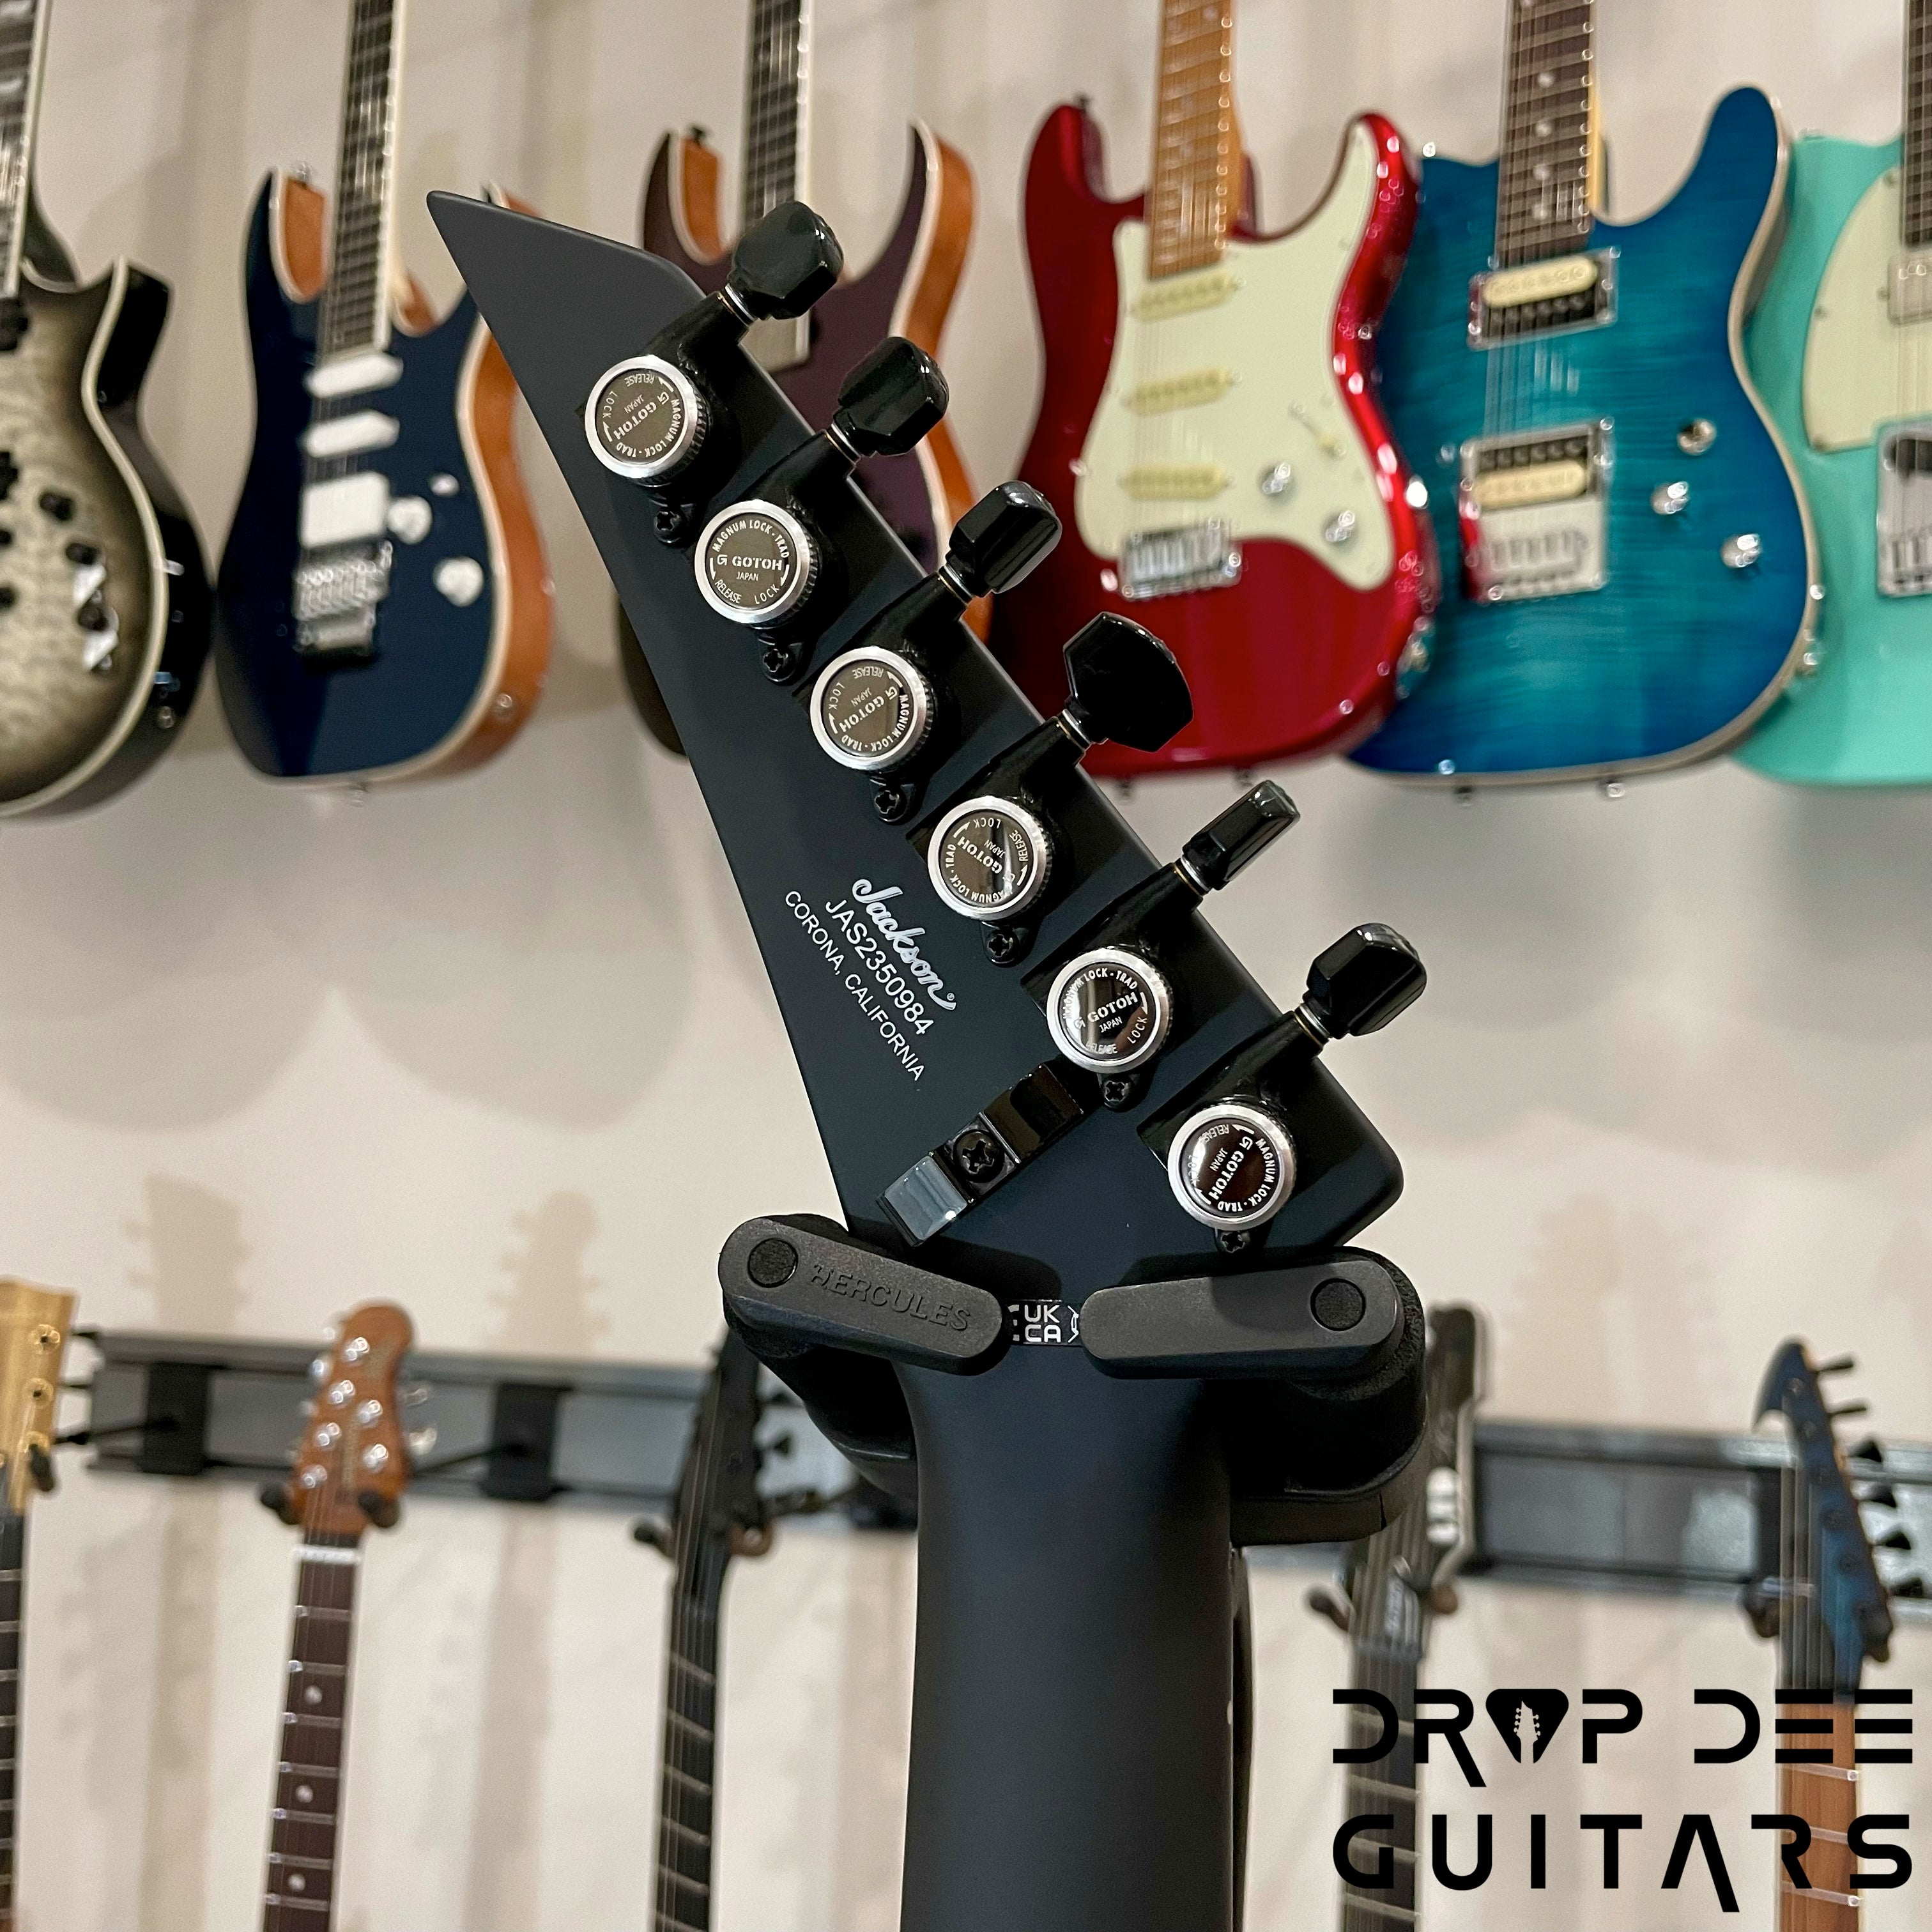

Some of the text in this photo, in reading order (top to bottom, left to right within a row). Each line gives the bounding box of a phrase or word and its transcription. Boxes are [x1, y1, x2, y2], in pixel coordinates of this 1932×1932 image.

[624, 373, 656, 387] RELEASE
[602, 391, 617, 418] LOCK
[624, 395, 644, 414] JAPAN
[613, 402, 657, 440] GOTOH
[617, 399, 681, 457] MAGNUM LOCK TRAD
[712, 519, 790, 558] MAGNUM LOCK TRAD
[732, 556, 783, 570] GOTOH
[736, 572, 758, 581] JAPAN
[715, 579, 742, 603] RELEASE
[755, 584, 779, 604] LOCK
[852, 666, 884, 678] RELEASE
[829, 682, 845, 710] LOCK
[851, 687, 872, 706] JAPAN
[839, 696, 884, 732] GOTOH
[841, 694, 909, 751] MAGNUM LOCK TRAD
[973, 818, 1001, 829] LOCK
[946, 844, 956, 868] TRAD
[958, 837, 1002, 873] GOTOH
[984, 839, 1006, 858] JAPAN
[1009, 830, 1028, 861] RELEASE
[950, 874, 970, 896] LOCK
[825, 900, 934, 1035] JAS2350984
[1085, 967, 1108, 981] LOCK
[1117, 970, 1137, 990] TRAD
[785, 891, 924, 1081] CORONA, CALIFORNIA
[1087, 992, 1138, 1022] GOTOH
[1099, 1016, 1123, 1033] JAPAN
[1127, 1016, 1147, 1044] LOCK
[1209, 1147, 1228, 1171] JAPAN
[1209, 1151, 1244, 1200] GOTOH
[1218, 1138, 1275, 1211] MAGNUM LOCK TRAD
[811, 1264, 970, 1331] HERCULES
[1024, 1305, 1061, 1322] UK
